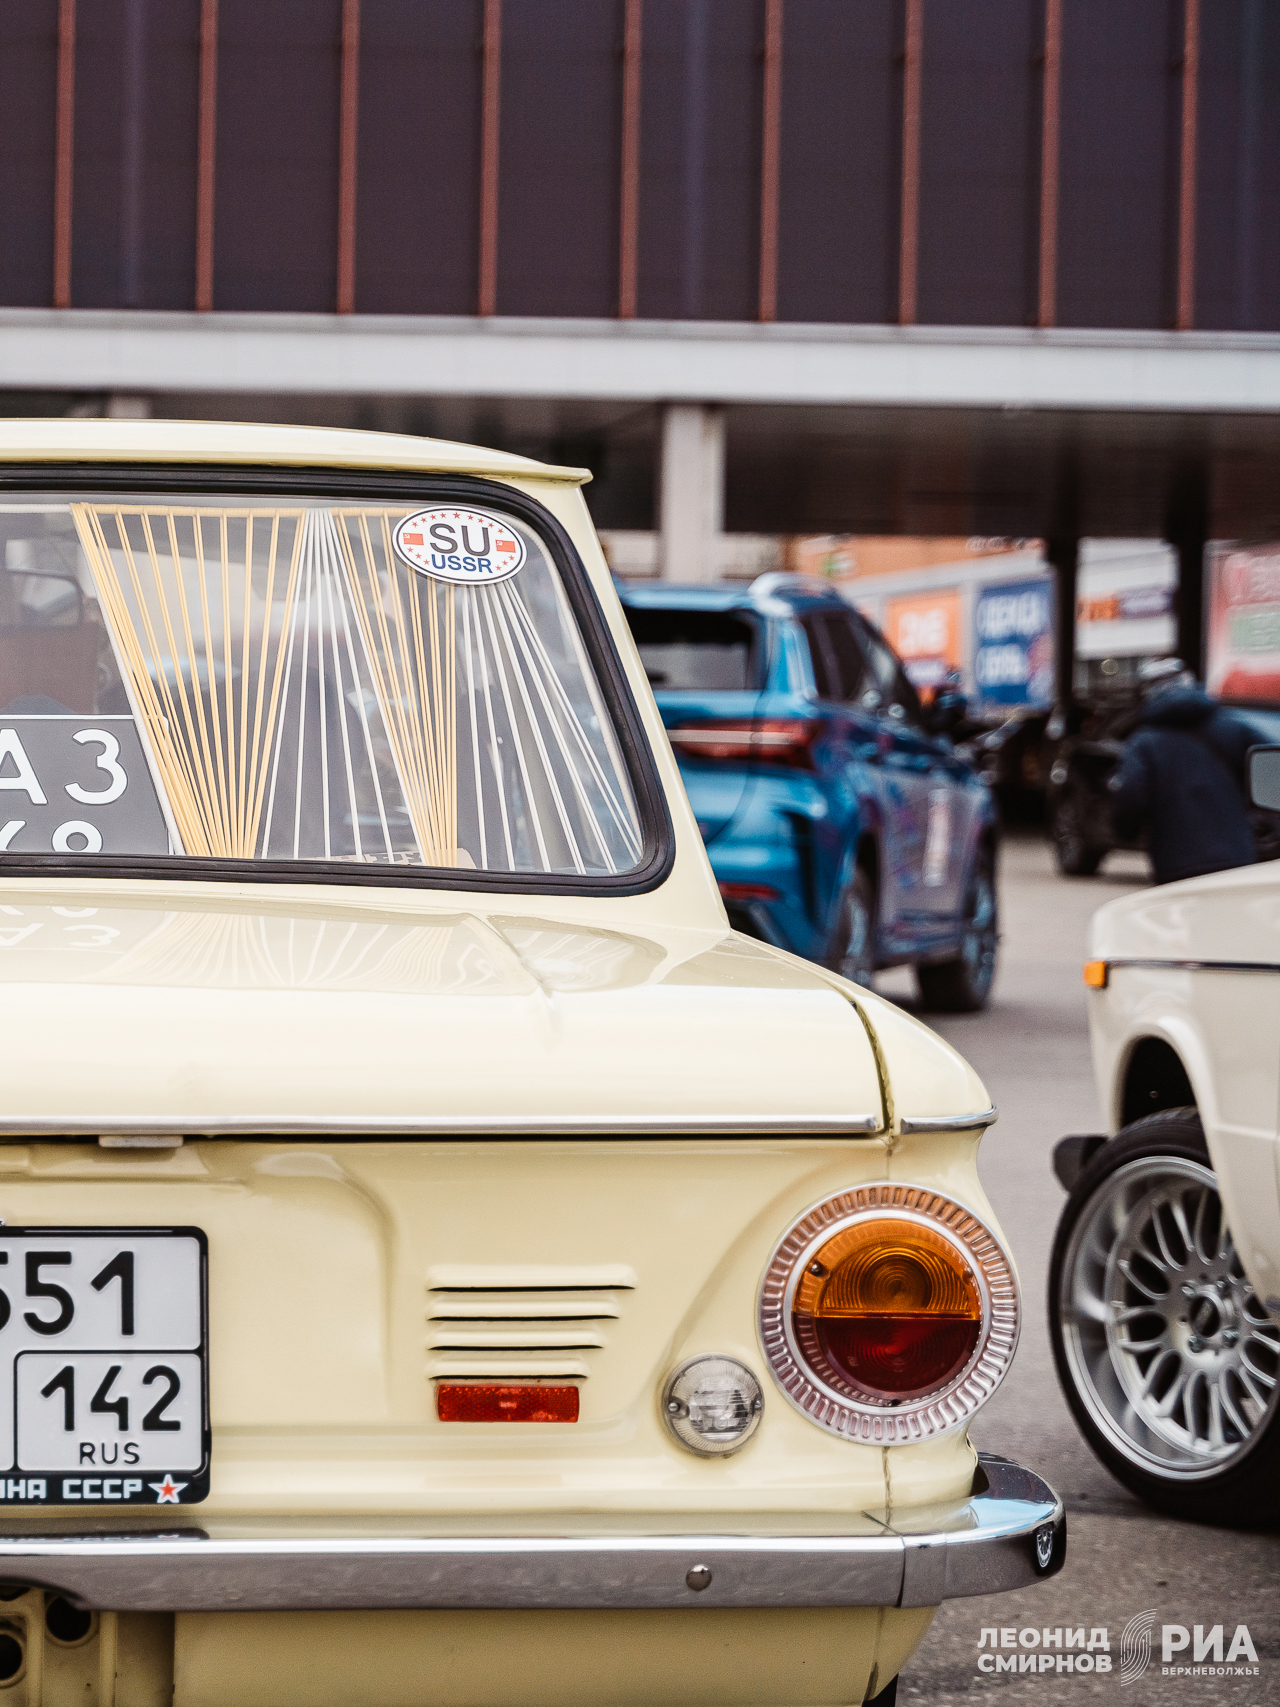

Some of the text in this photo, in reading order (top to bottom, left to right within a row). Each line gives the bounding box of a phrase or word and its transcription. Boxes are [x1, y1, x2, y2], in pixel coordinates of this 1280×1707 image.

[429, 523, 491, 557] SU
[431, 554, 493, 574] USSR
[40, 1365, 181, 1432] 142
[79, 1442, 141, 1465] RUS
[62, 1478, 143, 1499] СССР
